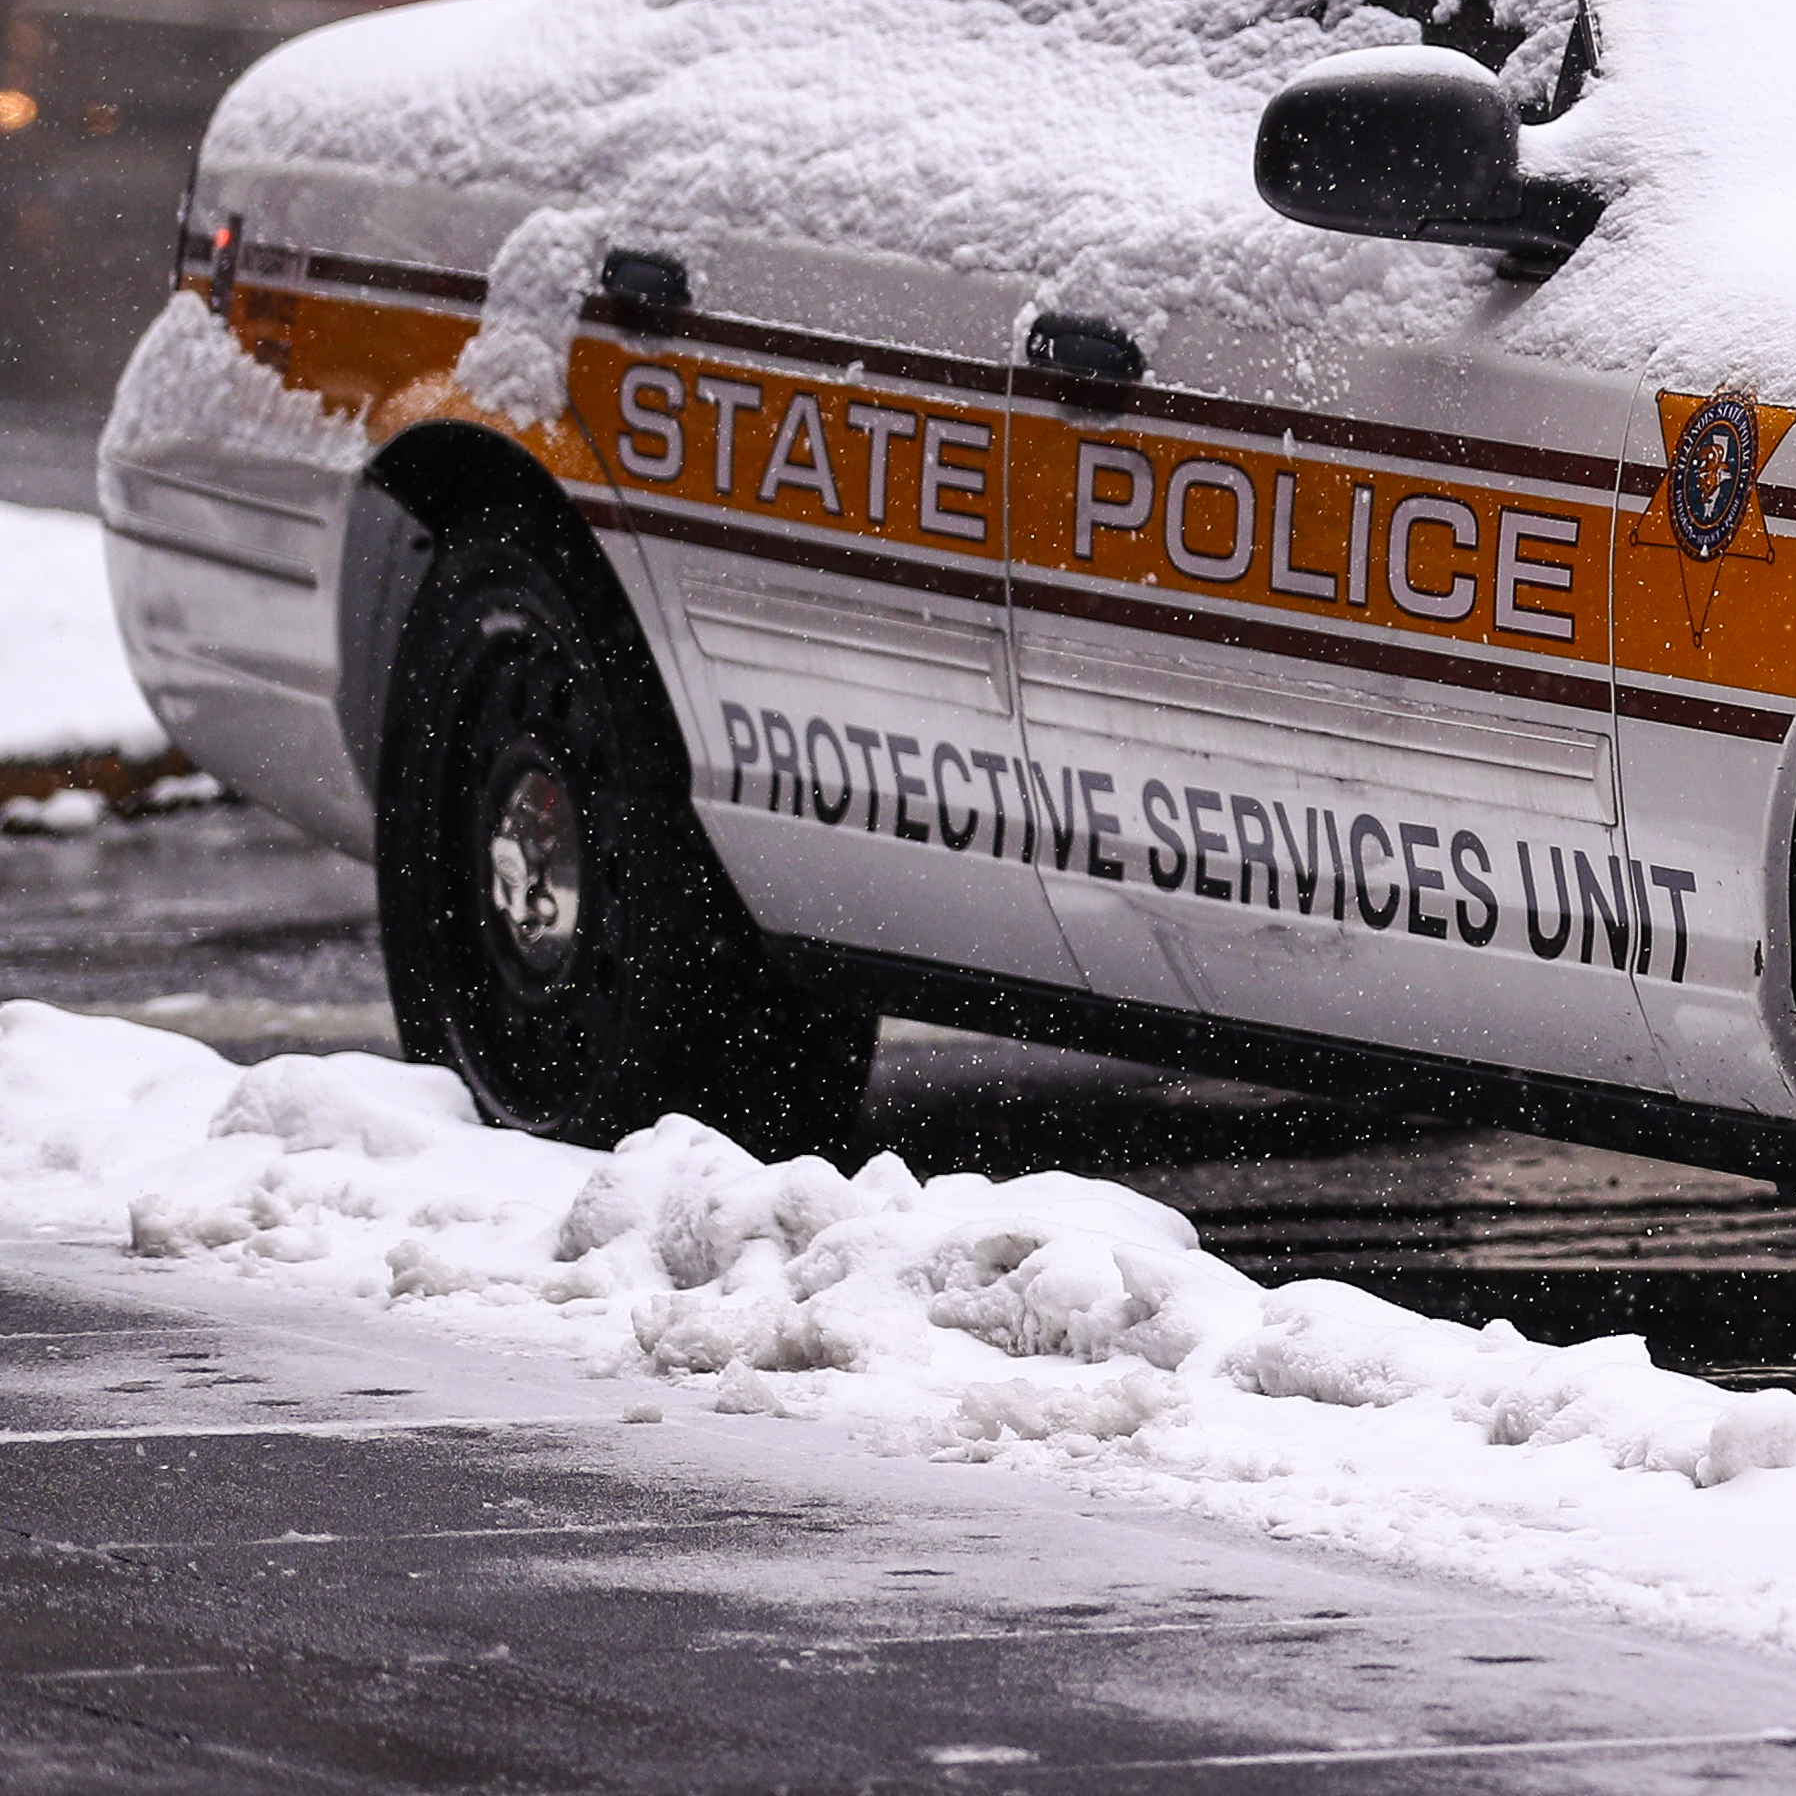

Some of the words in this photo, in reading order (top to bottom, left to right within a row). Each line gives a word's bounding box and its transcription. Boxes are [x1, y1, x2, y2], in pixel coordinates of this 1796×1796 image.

[616, 361, 993, 542] STATE
[1072, 439, 1582, 644] POLICE
[1717, 401, 1745, 426] STATE
[720, 700, 1124, 881] PROTECTIVE
[1142, 777, 1499, 948] SERVICES
[1516, 840, 1697, 984] UNIT
